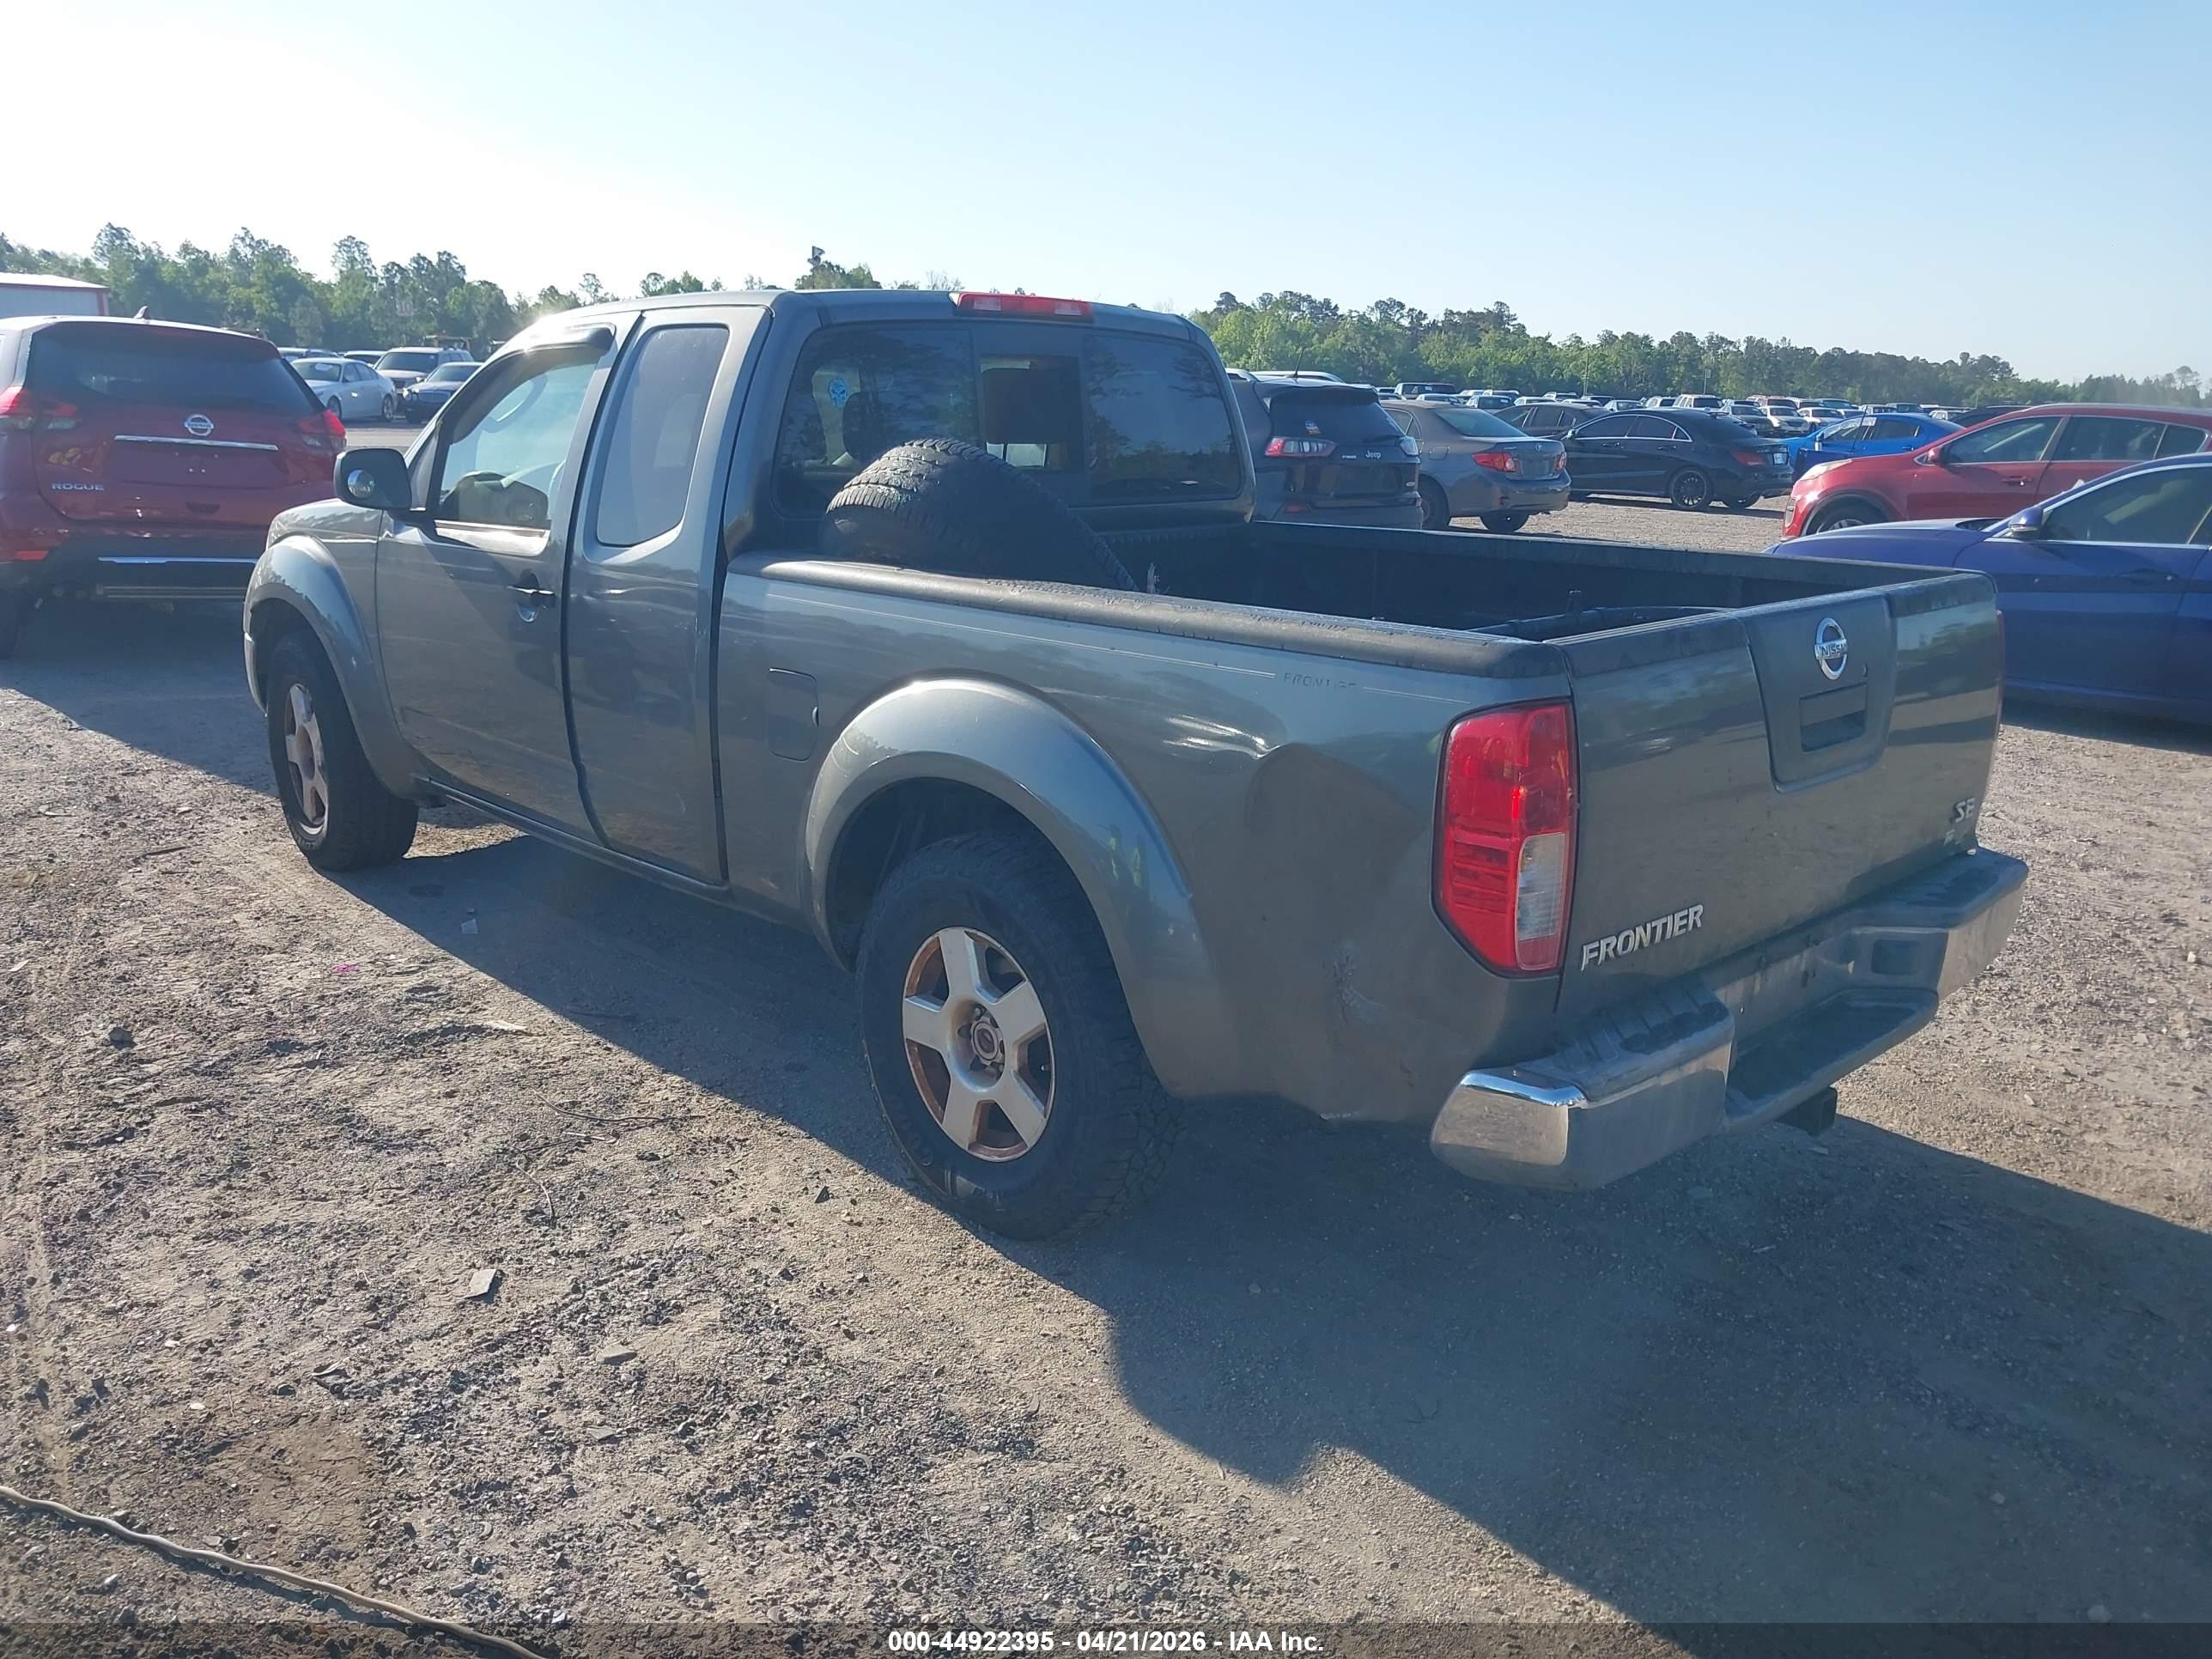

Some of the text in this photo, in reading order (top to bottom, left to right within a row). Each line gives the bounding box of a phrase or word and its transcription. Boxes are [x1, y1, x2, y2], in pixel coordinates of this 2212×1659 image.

[1365, 450, 1382, 459] Jeep
[52, 483, 105, 491] ROGUE
[1580, 904, 1704, 971] FRONTIER
